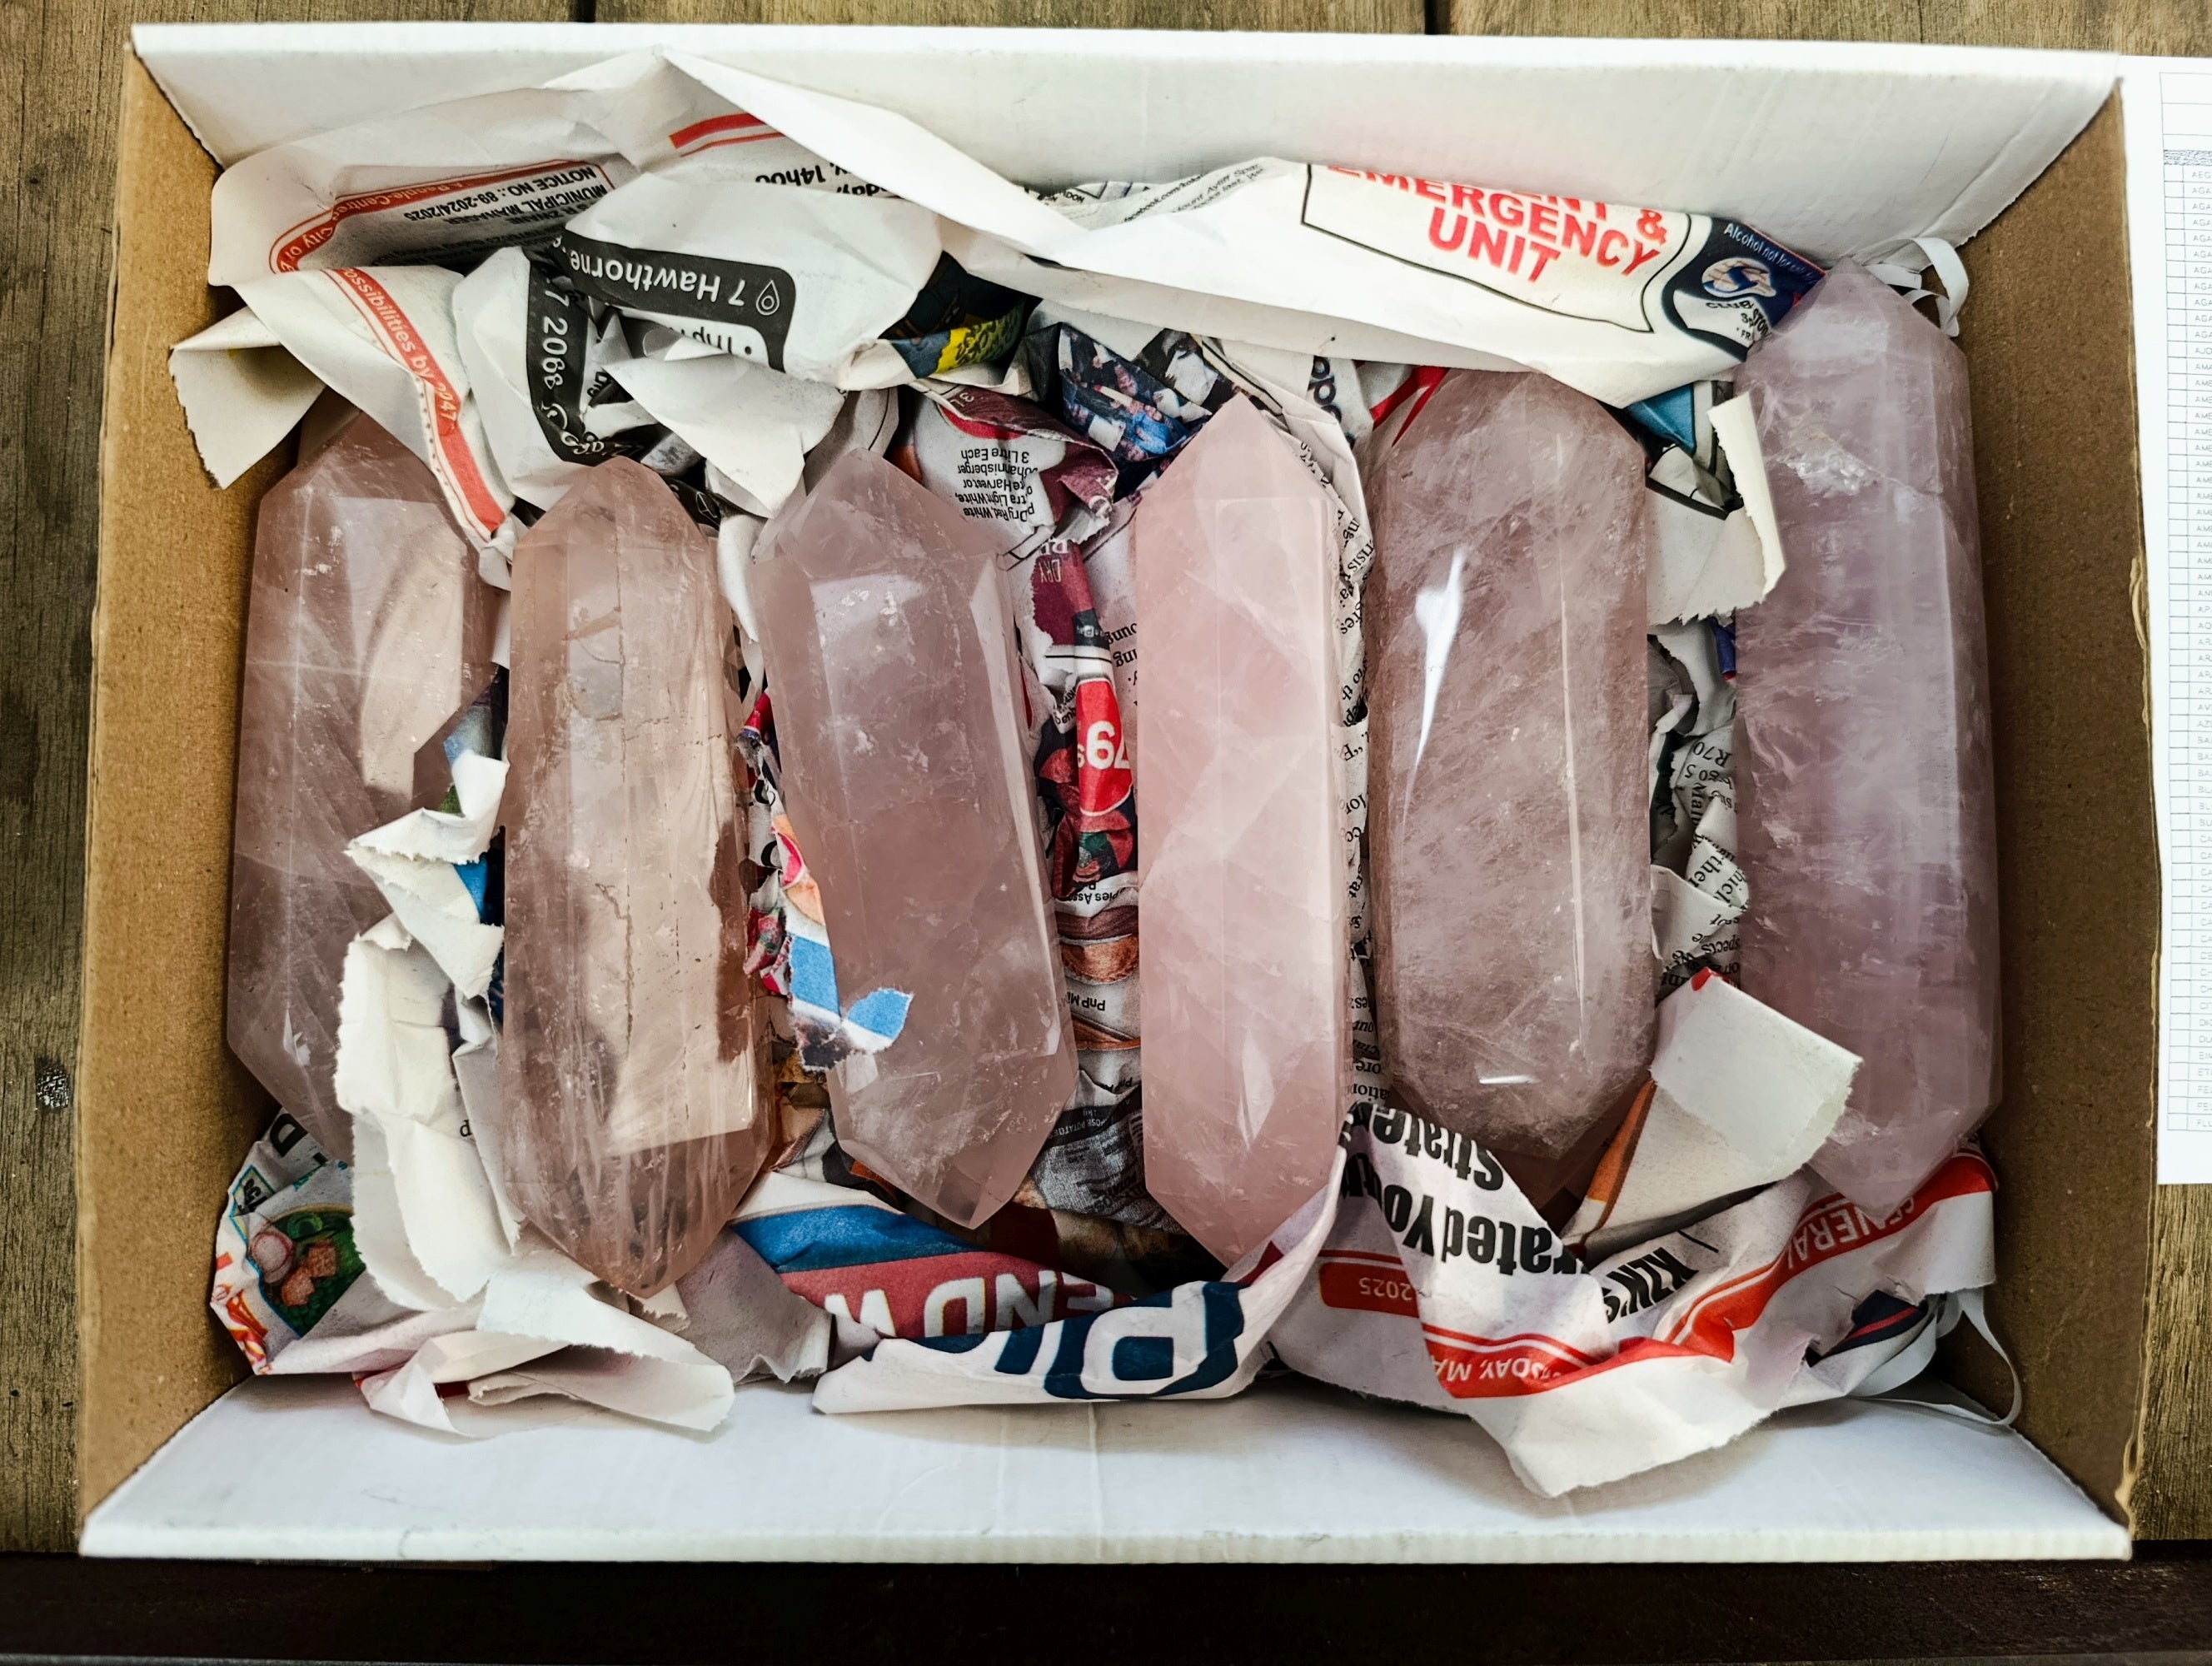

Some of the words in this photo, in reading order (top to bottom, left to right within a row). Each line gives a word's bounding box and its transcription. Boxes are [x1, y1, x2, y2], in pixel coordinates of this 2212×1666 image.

[497, 179, 536, 199] NO.:
[537, 166, 597, 191] NOTICE
[403, 189, 490, 222] 89-2024/2025
[521, 184, 607, 215] MUNICIPAL
[450, 202, 531, 226] MANAGER
[1328, 167, 1661, 277] MERGENCY
[1637, 208, 1666, 246] &
[1428, 207, 1562, 283] UNIT
[1723, 222, 1763, 253] Alcohol
[1761, 247, 1780, 262] not
[544, 290, 570, 307] 7
[727, 278, 746, 307] 7
[411, 355, 434, 377] by
[960, 449, 989, 464] Each
[991, 448, 1019, 464] Litre
[1021, 451, 1030, 464] 3
[962, 479, 973, 489] or
[972, 478, 1012, 492] Harvest
[954, 492, 988, 506] White,
[984, 491, 1009, 507] Light
[1010, 493, 1029, 506] tra
[962, 507, 993, 519] White
[991, 506, 1009, 521] Red,
[1008, 506, 1028, 521] Dry
[1085, 720, 1131, 771] 79
[1692, 741, 1732, 770] R70
[1081, 996, 1107, 1012] PnP
[1358, 1275, 1413, 1302] 2025
[1478, 1356, 1562, 1379] SDAY,
